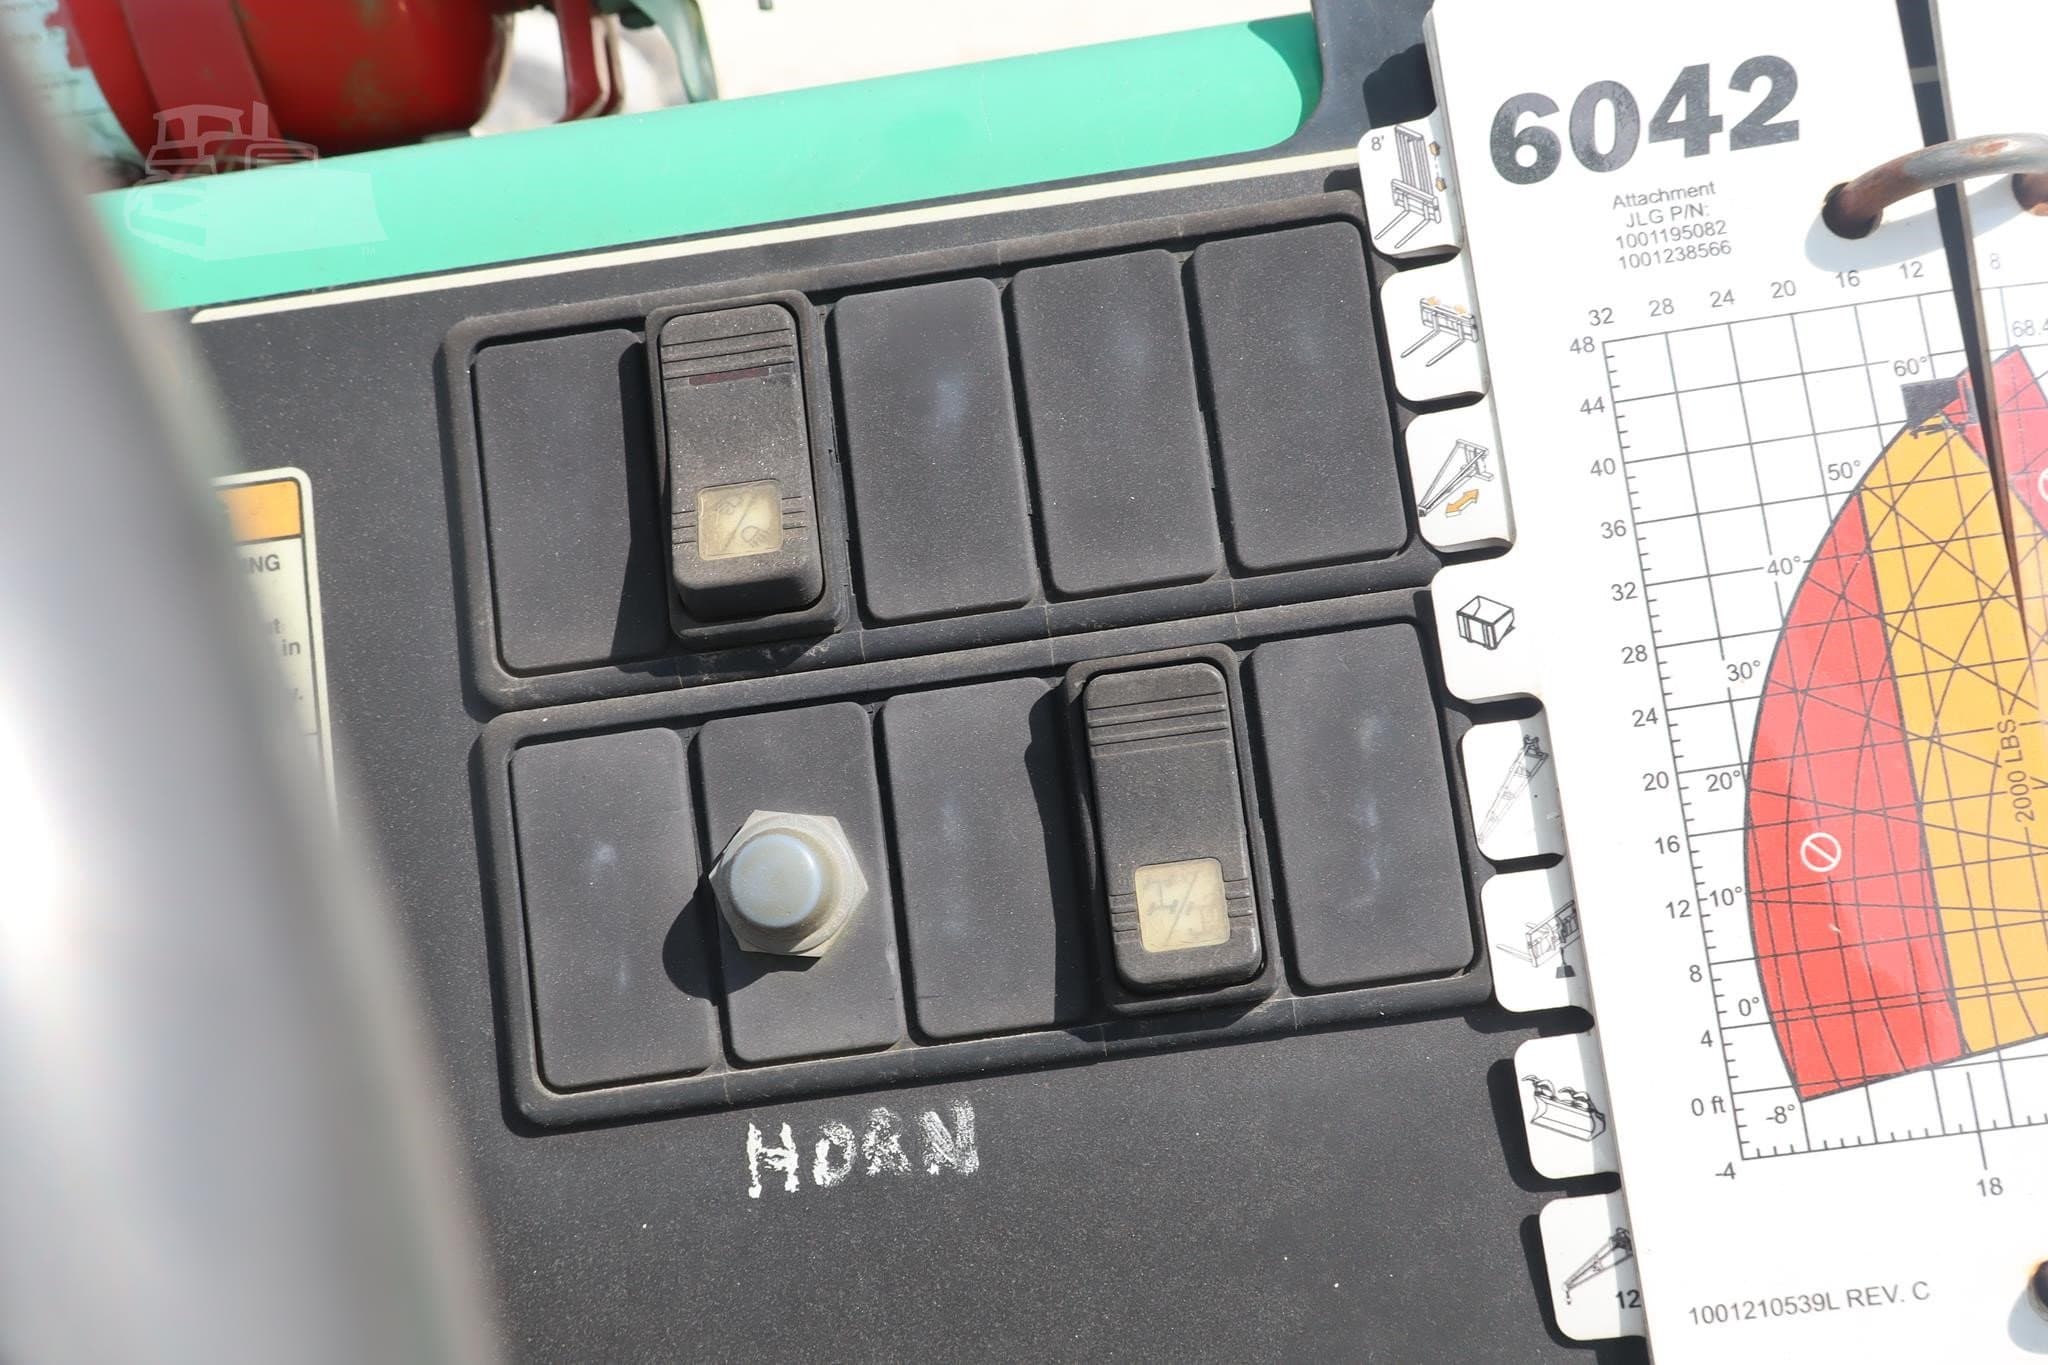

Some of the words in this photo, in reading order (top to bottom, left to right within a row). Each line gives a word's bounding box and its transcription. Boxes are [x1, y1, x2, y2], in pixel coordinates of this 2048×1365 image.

[1490, 55, 1799, 185] 6042
[1612, 181, 1717, 210] Attachment
[1625, 208, 1664, 228] JLG
[1670, 202, 1711, 221] P/N:
[1615, 219, 1729, 249] 1001195082
[1619, 240, 1732, 270] 1001238566
[1588, 307, 1615, 327] 32
[1648, 298, 1676, 319] 28
[1709, 288, 1736, 308] 24
[1771, 280, 1797, 300] 20
[1836, 270, 1861, 289] 16
[1898, 261, 1925, 280] 12
[1989, 253, 2001, 270] 8
[1569, 336, 1596, 356] 48
[1893, 355, 1928, 377] 60°
[1579, 397, 1606, 417] 44
[1590, 457, 1617, 477] 40
[1827, 459, 1862, 481] 50°
[1600, 519, 1627, 540] 36
[1767, 555, 1802, 577] 40°
[1611, 581, 1638, 602] 32
[1621, 645, 1648, 665] 28
[1726, 660, 1761, 682] 30°
[1631, 708, 1659, 728] 24
[1996, 718, 2024, 764] LBS
[1643, 770, 1670, 791] 20
[1706, 770, 1741, 793] 20°
[2006, 769, 2036, 823] 2000
[1655, 835, 1681, 855] 16
[1709, 886, 1744, 909] 10°
[1666, 899, 1692, 920] 12
[1689, 963, 1703, 984] 8
[1738, 996, 1760, 1017] 0°
[1700, 1030, 1714, 1049] 4
[1691, 1098, 1705, 1118] 0
[1711, 1095, 1727, 1116] ft
[1715, 1161, 1737, 1181] -4
[1977, 1177, 2004, 1198] 18
[1616, 1289, 1642, 1309] 12
[1688, 1292, 1841, 1326] 1001210539L
[1846, 1284, 1906, 1309] REV.
[1911, 1280, 1931, 1301] C
